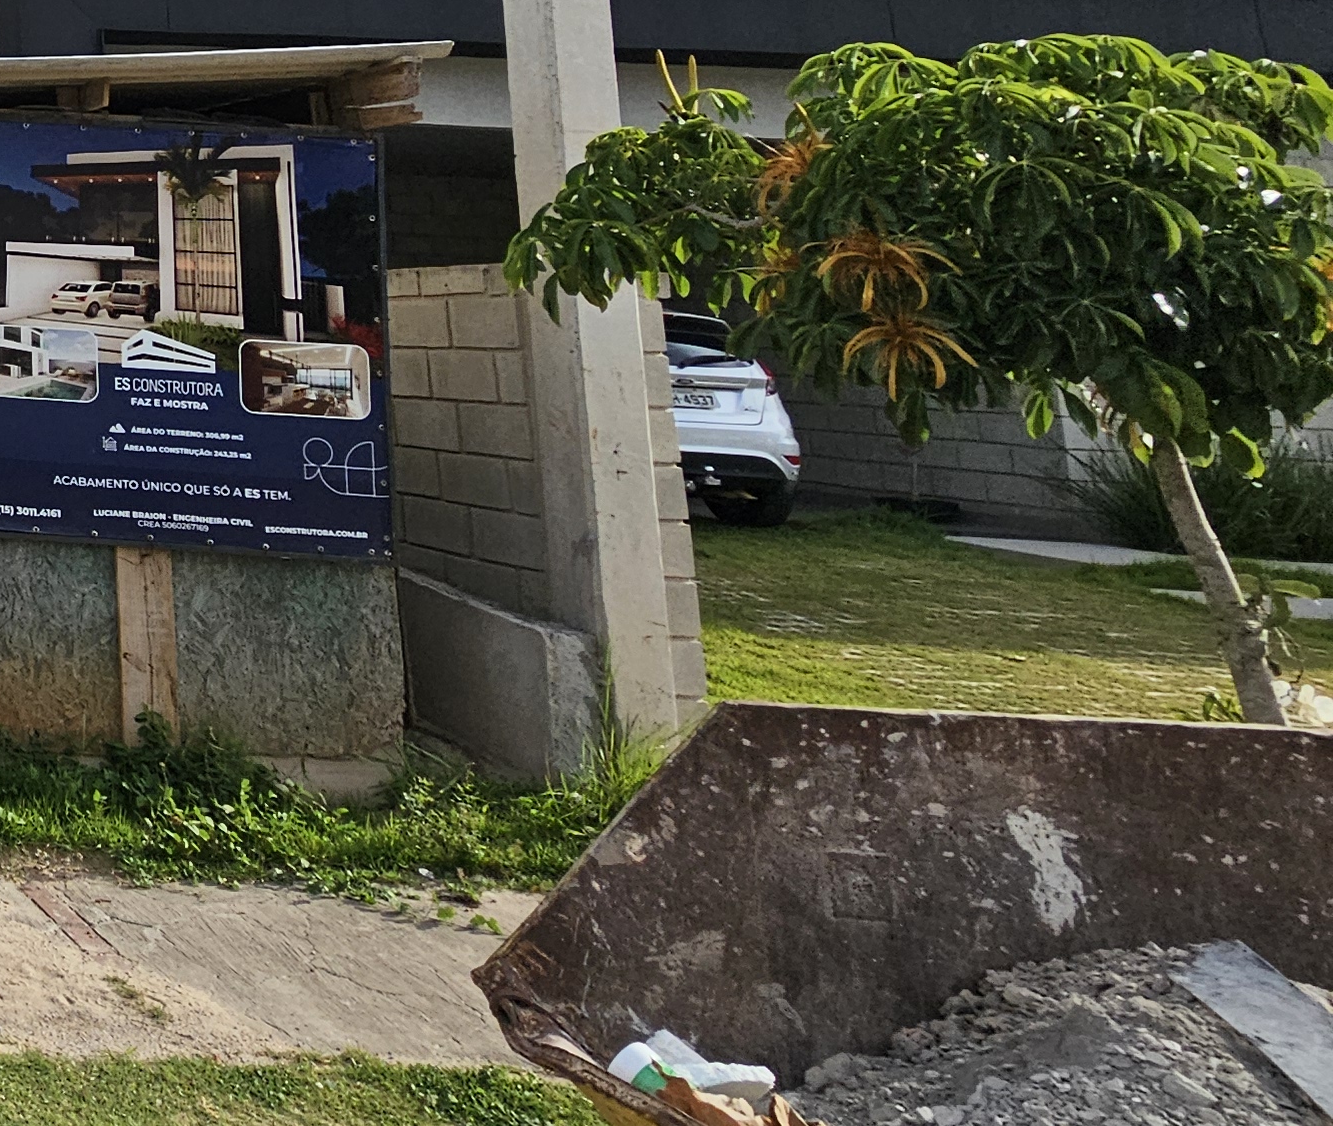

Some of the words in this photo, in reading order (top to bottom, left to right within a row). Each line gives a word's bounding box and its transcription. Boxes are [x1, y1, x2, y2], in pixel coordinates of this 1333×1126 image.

[114, 377, 130, 390] ES
[132, 378, 223, 397] CONSTRUTORA
[130, 397, 152, 407] FAZ
[153, 399, 161, 407] E
[163, 399, 209, 410] MOSTRA
[130, 426, 152, 435] ÁREA
[153, 428, 165, 436] DO
[166, 429, 204, 438] TERRENO:
[123, 443, 145, 452] ÁREA
[145, 445, 158, 453] DA
[159, 446, 213, 458] CONSTRUÇÃO:
[239, 452, 252, 460] m2
[53, 475, 139, 489] ACABAMENTO
[141, 479, 181, 493] ÚNICO
[183, 483, 210, 495] QUE
[213, 485, 231, 497] SÓ
[232, 487, 242, 498] A
[244, 488, 261, 499] ES
[263, 489, 292, 501] TEM.
[16, 506, 62, 519] 3011.4161
[93, 509, 131, 518] LUCIANE
[173, 513, 229, 525] ENGENHEIRA
[230, 518, 254, 527] CIVIL
[137, 519, 161, 528] CREA
[265, 526, 368, 539] ESCONSTRUTORA.COM.BR
